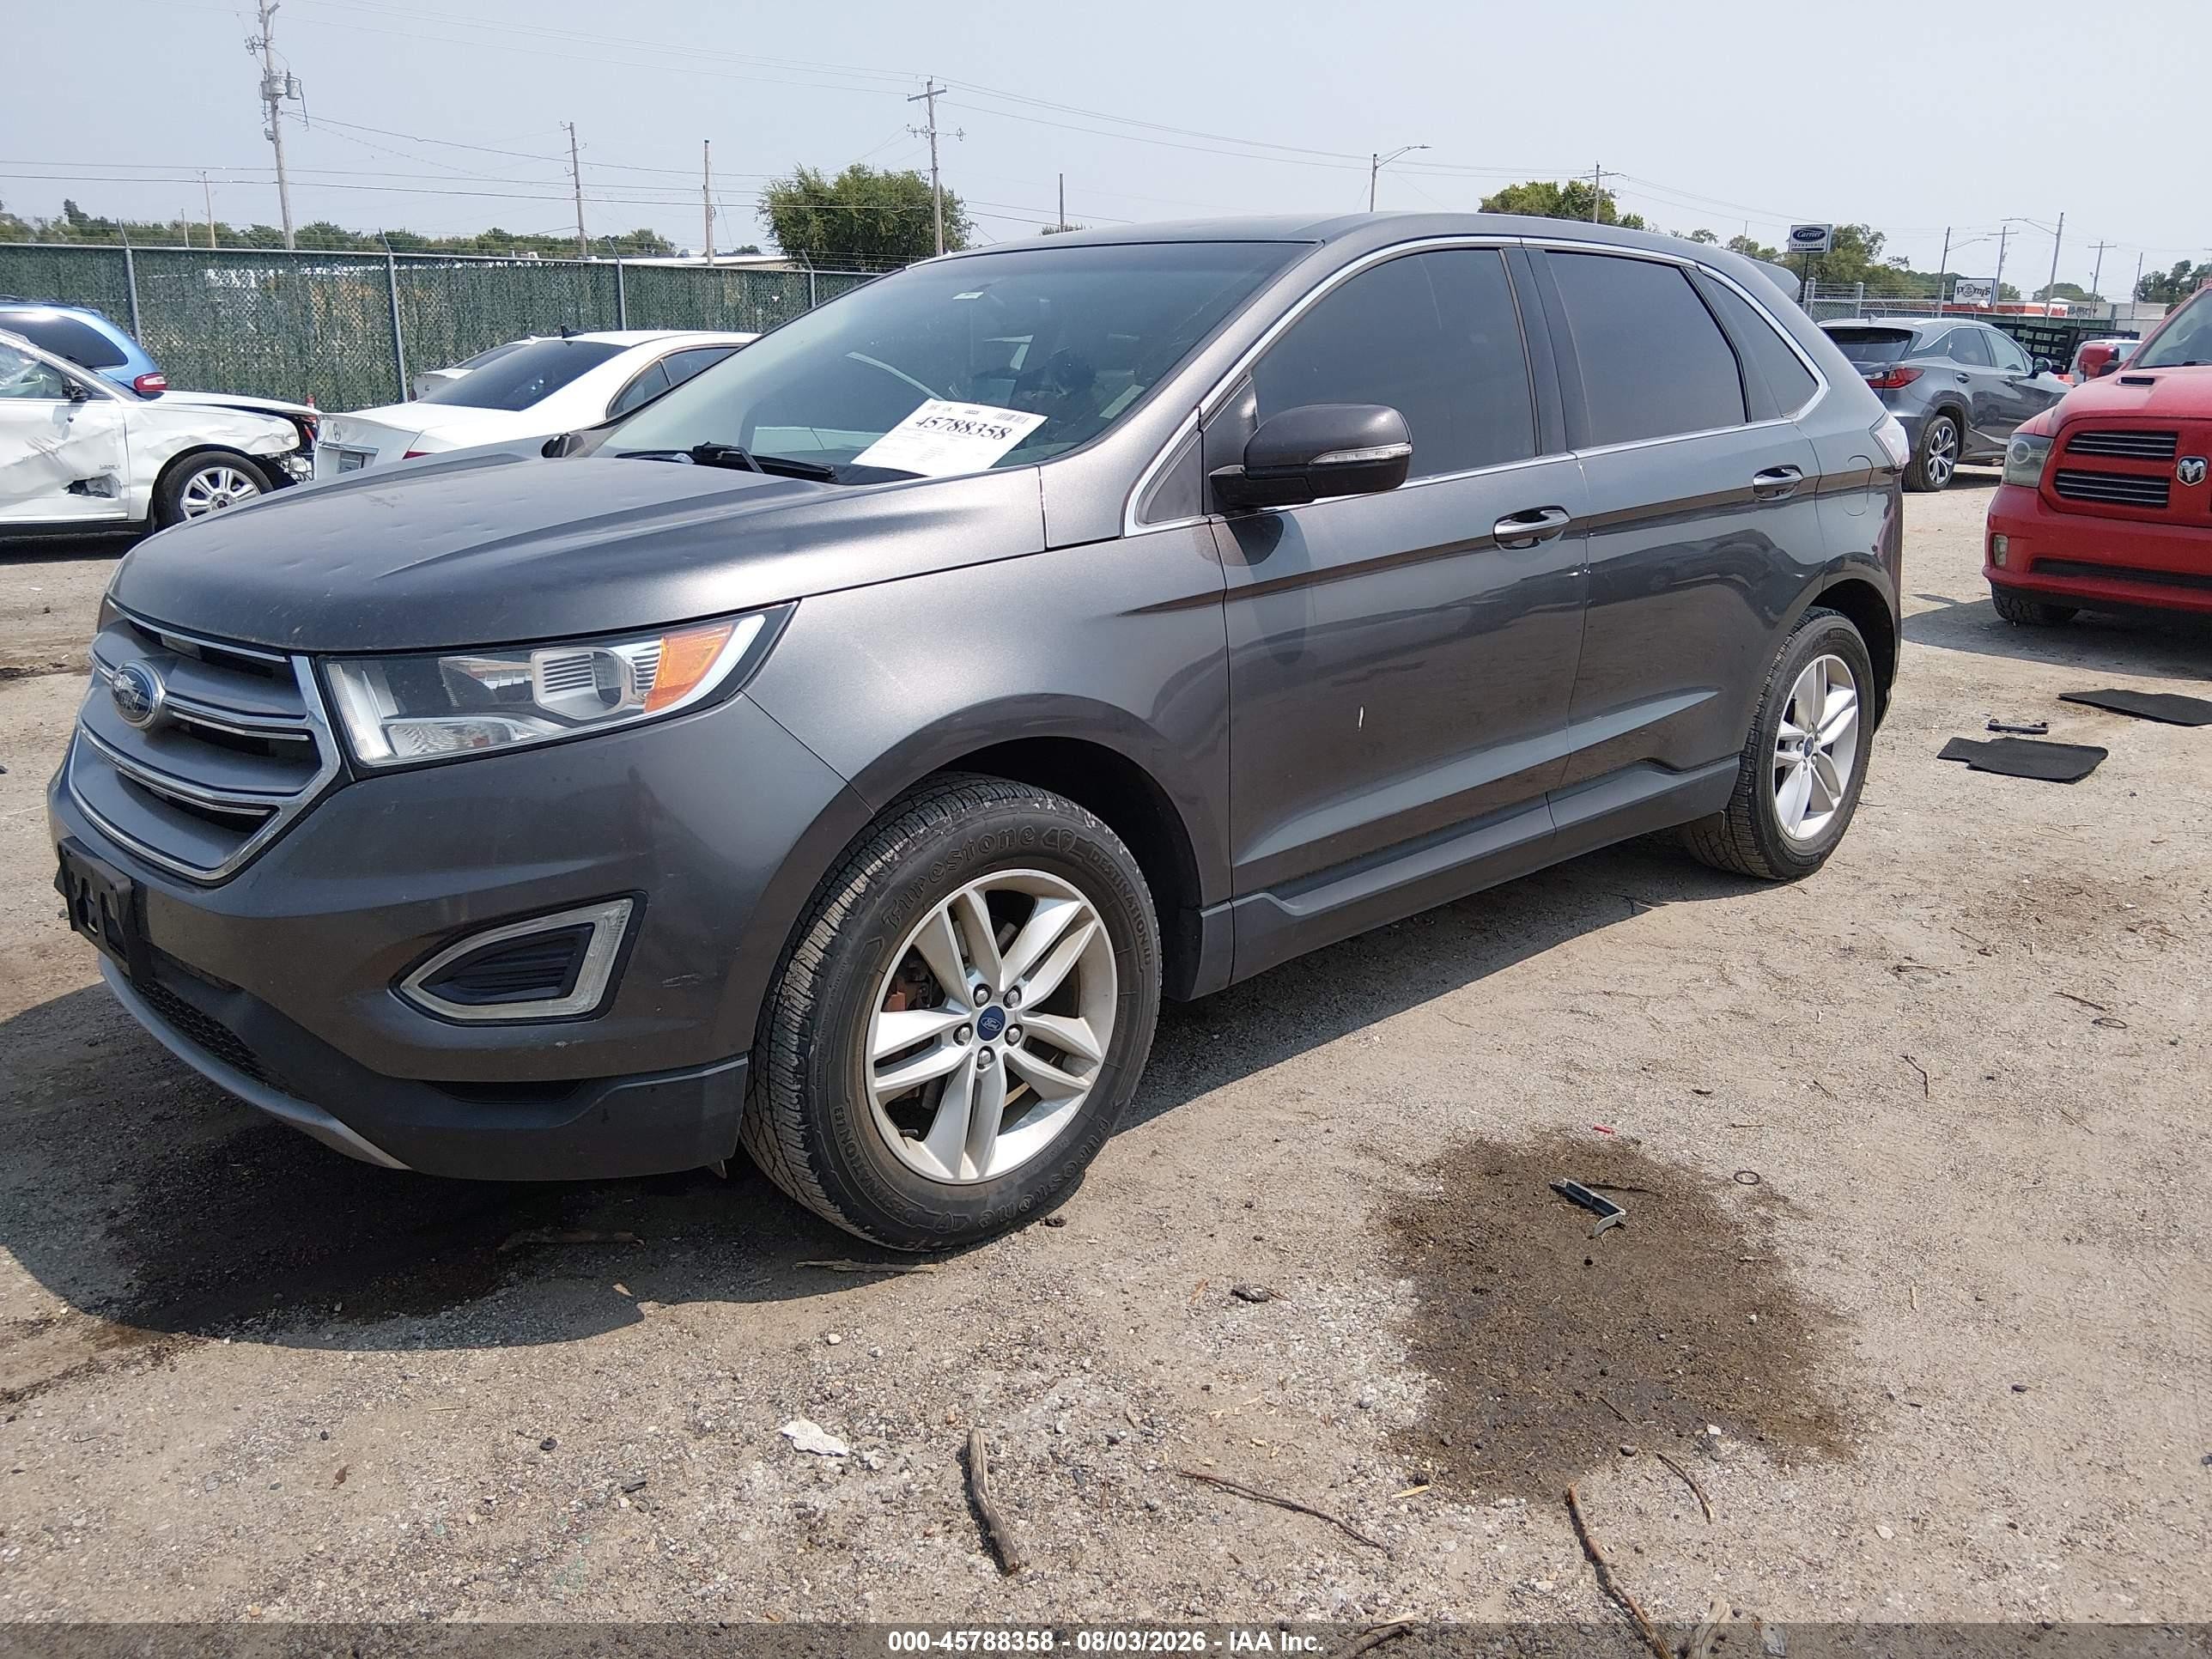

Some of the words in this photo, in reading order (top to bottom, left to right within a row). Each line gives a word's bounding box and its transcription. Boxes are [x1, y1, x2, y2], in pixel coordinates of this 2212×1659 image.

[1797, 229, 1822, 238] Carrier
[915, 416, 1012, 441] 45788358
[881, 827, 1036, 929] Firestone
[1090, 848, 1148, 945] DESTINATION
